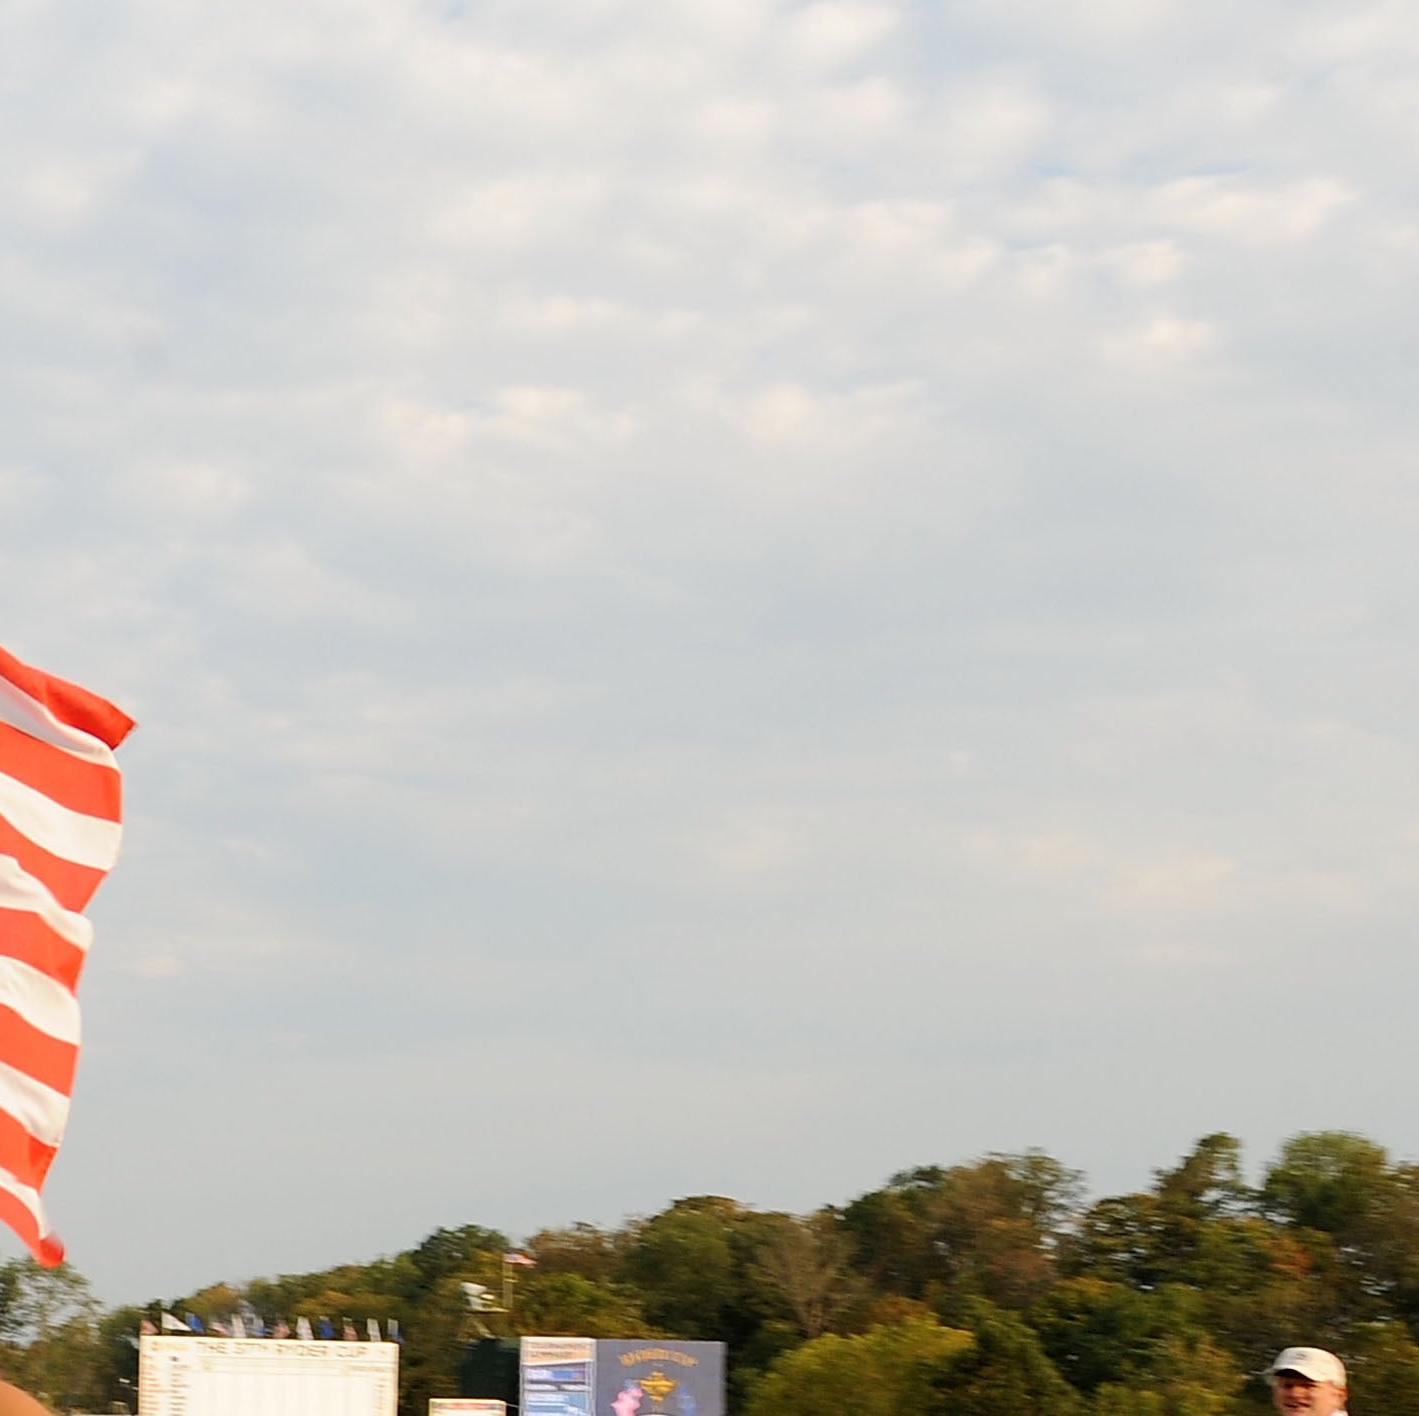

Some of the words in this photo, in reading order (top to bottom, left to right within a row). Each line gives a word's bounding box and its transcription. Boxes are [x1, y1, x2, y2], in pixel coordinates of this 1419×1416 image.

[196, 1341, 228, 1354] THE
[276, 1343, 328, 1357] RYDER
[338, 1345, 368, 1358] CUP
